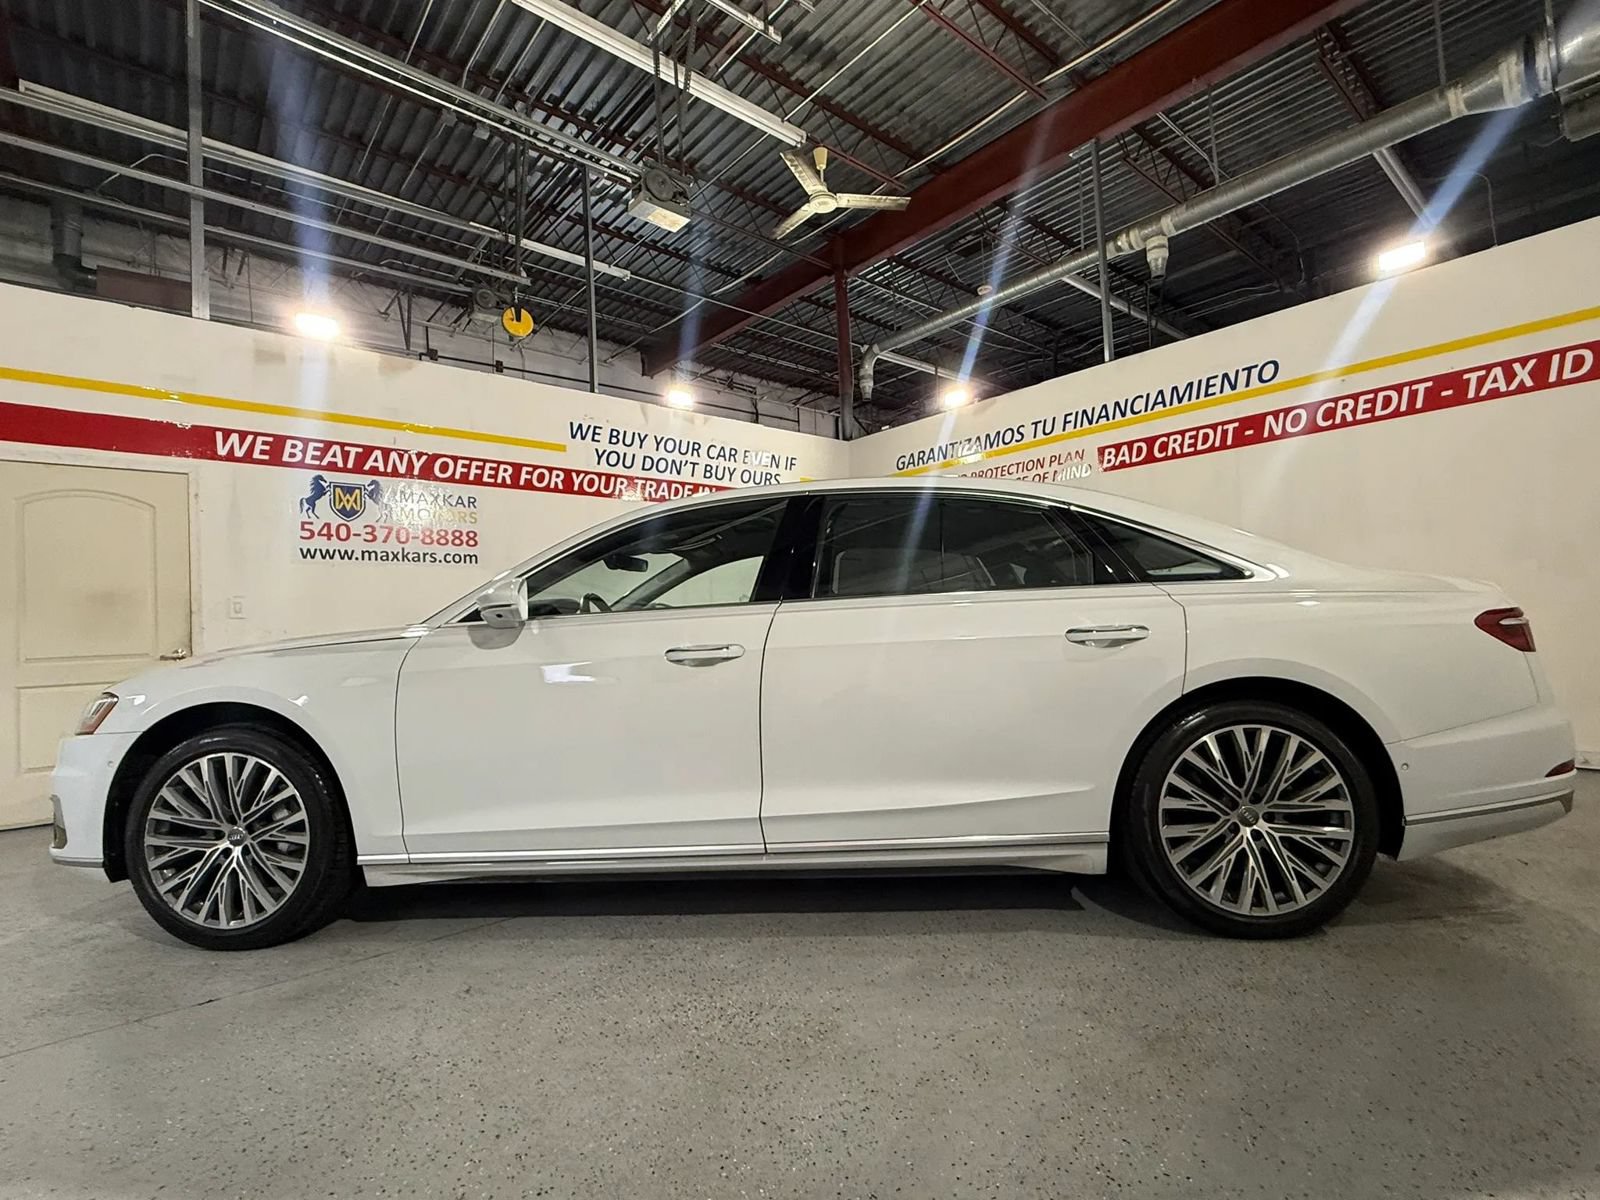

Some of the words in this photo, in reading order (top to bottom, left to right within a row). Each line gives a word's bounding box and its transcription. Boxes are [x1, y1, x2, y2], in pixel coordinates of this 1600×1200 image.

[1031, 418, 1056, 437] TU
[1062, 359, 1280, 432] FINANCIAMIENTO
[1102, 441, 1147, 470] BAD
[1153, 422, 1240, 459] CREDIT
[1263, 409, 1308, 439] NO
[1316, 380, 1433, 428] CREDIT
[1463, 357, 1538, 398] TAX
[1548, 348, 1593, 382] ID
[569, 421, 602, 442] WE
[608, 428, 648, 450] BUY
[654, 435, 701, 458] YOUR
[706, 444, 738, 463] CAR
[784, 456, 797, 471] IF
[1048, 449, 1085, 468] PLAN
[215, 431, 274, 460] WE
[282, 439, 364, 468] BEAT
[363, 449, 428, 475] ANY
[433, 456, 512, 485] OFFER
[519, 466, 565, 490] FOR
[571, 472, 628, 497] YOUR
[633, 478, 695, 501] TRADE
[594, 448, 634, 470] YOU
[703, 463, 737, 483] BUY
[740, 469, 781, 486] OURS
[399, 490, 477, 509] MAXKAR
[399, 508, 478, 524] MOORS
[299, 521, 479, 547] 540-370-8888
[299, 547, 479, 565] www.maxkars.com
